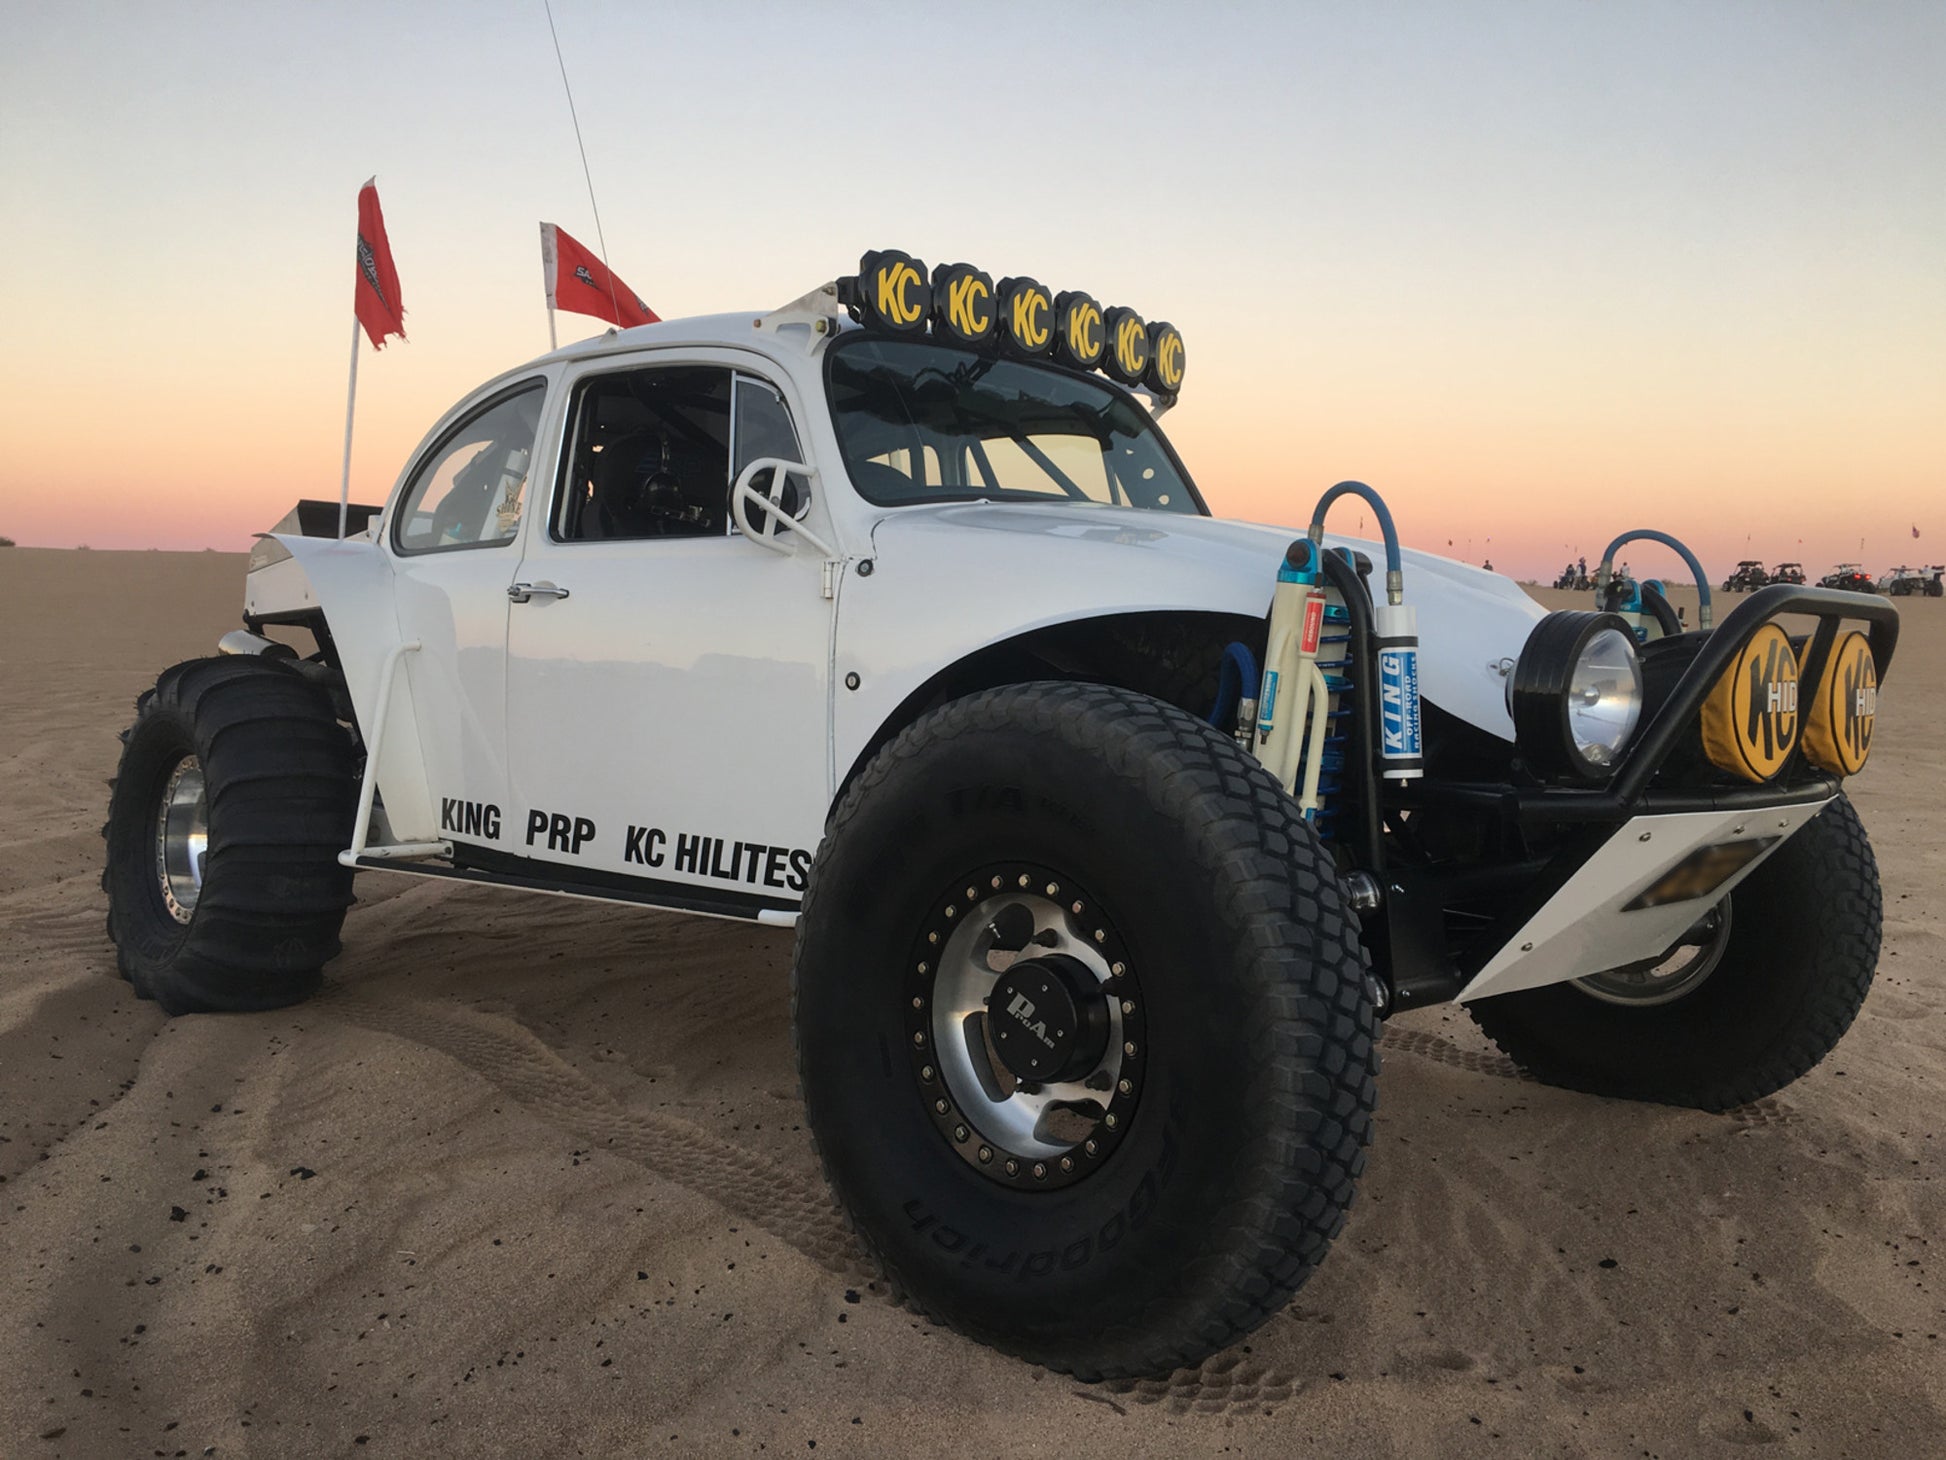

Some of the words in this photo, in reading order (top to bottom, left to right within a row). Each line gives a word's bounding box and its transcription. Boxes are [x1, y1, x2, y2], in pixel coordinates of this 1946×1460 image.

[878, 262, 921, 324] KC
[950, 275, 988, 335] KC
[1013, 289, 1048, 347] KC
[1070, 303, 1100, 359] KC
[1117, 318, 1144, 372] KC
[1159, 333, 1182, 384] KC
[1382, 656, 1404, 750] KING
[1404, 675, 1413, 737] OFF-ROAD
[1747, 639, 1795, 760] KC
[1844, 648, 1875, 760] KC
[441, 797, 500, 840] KING
[526, 809, 596, 855] PRP
[624, 825, 666, 868] KC
[675, 833, 812, 892] HILITES
